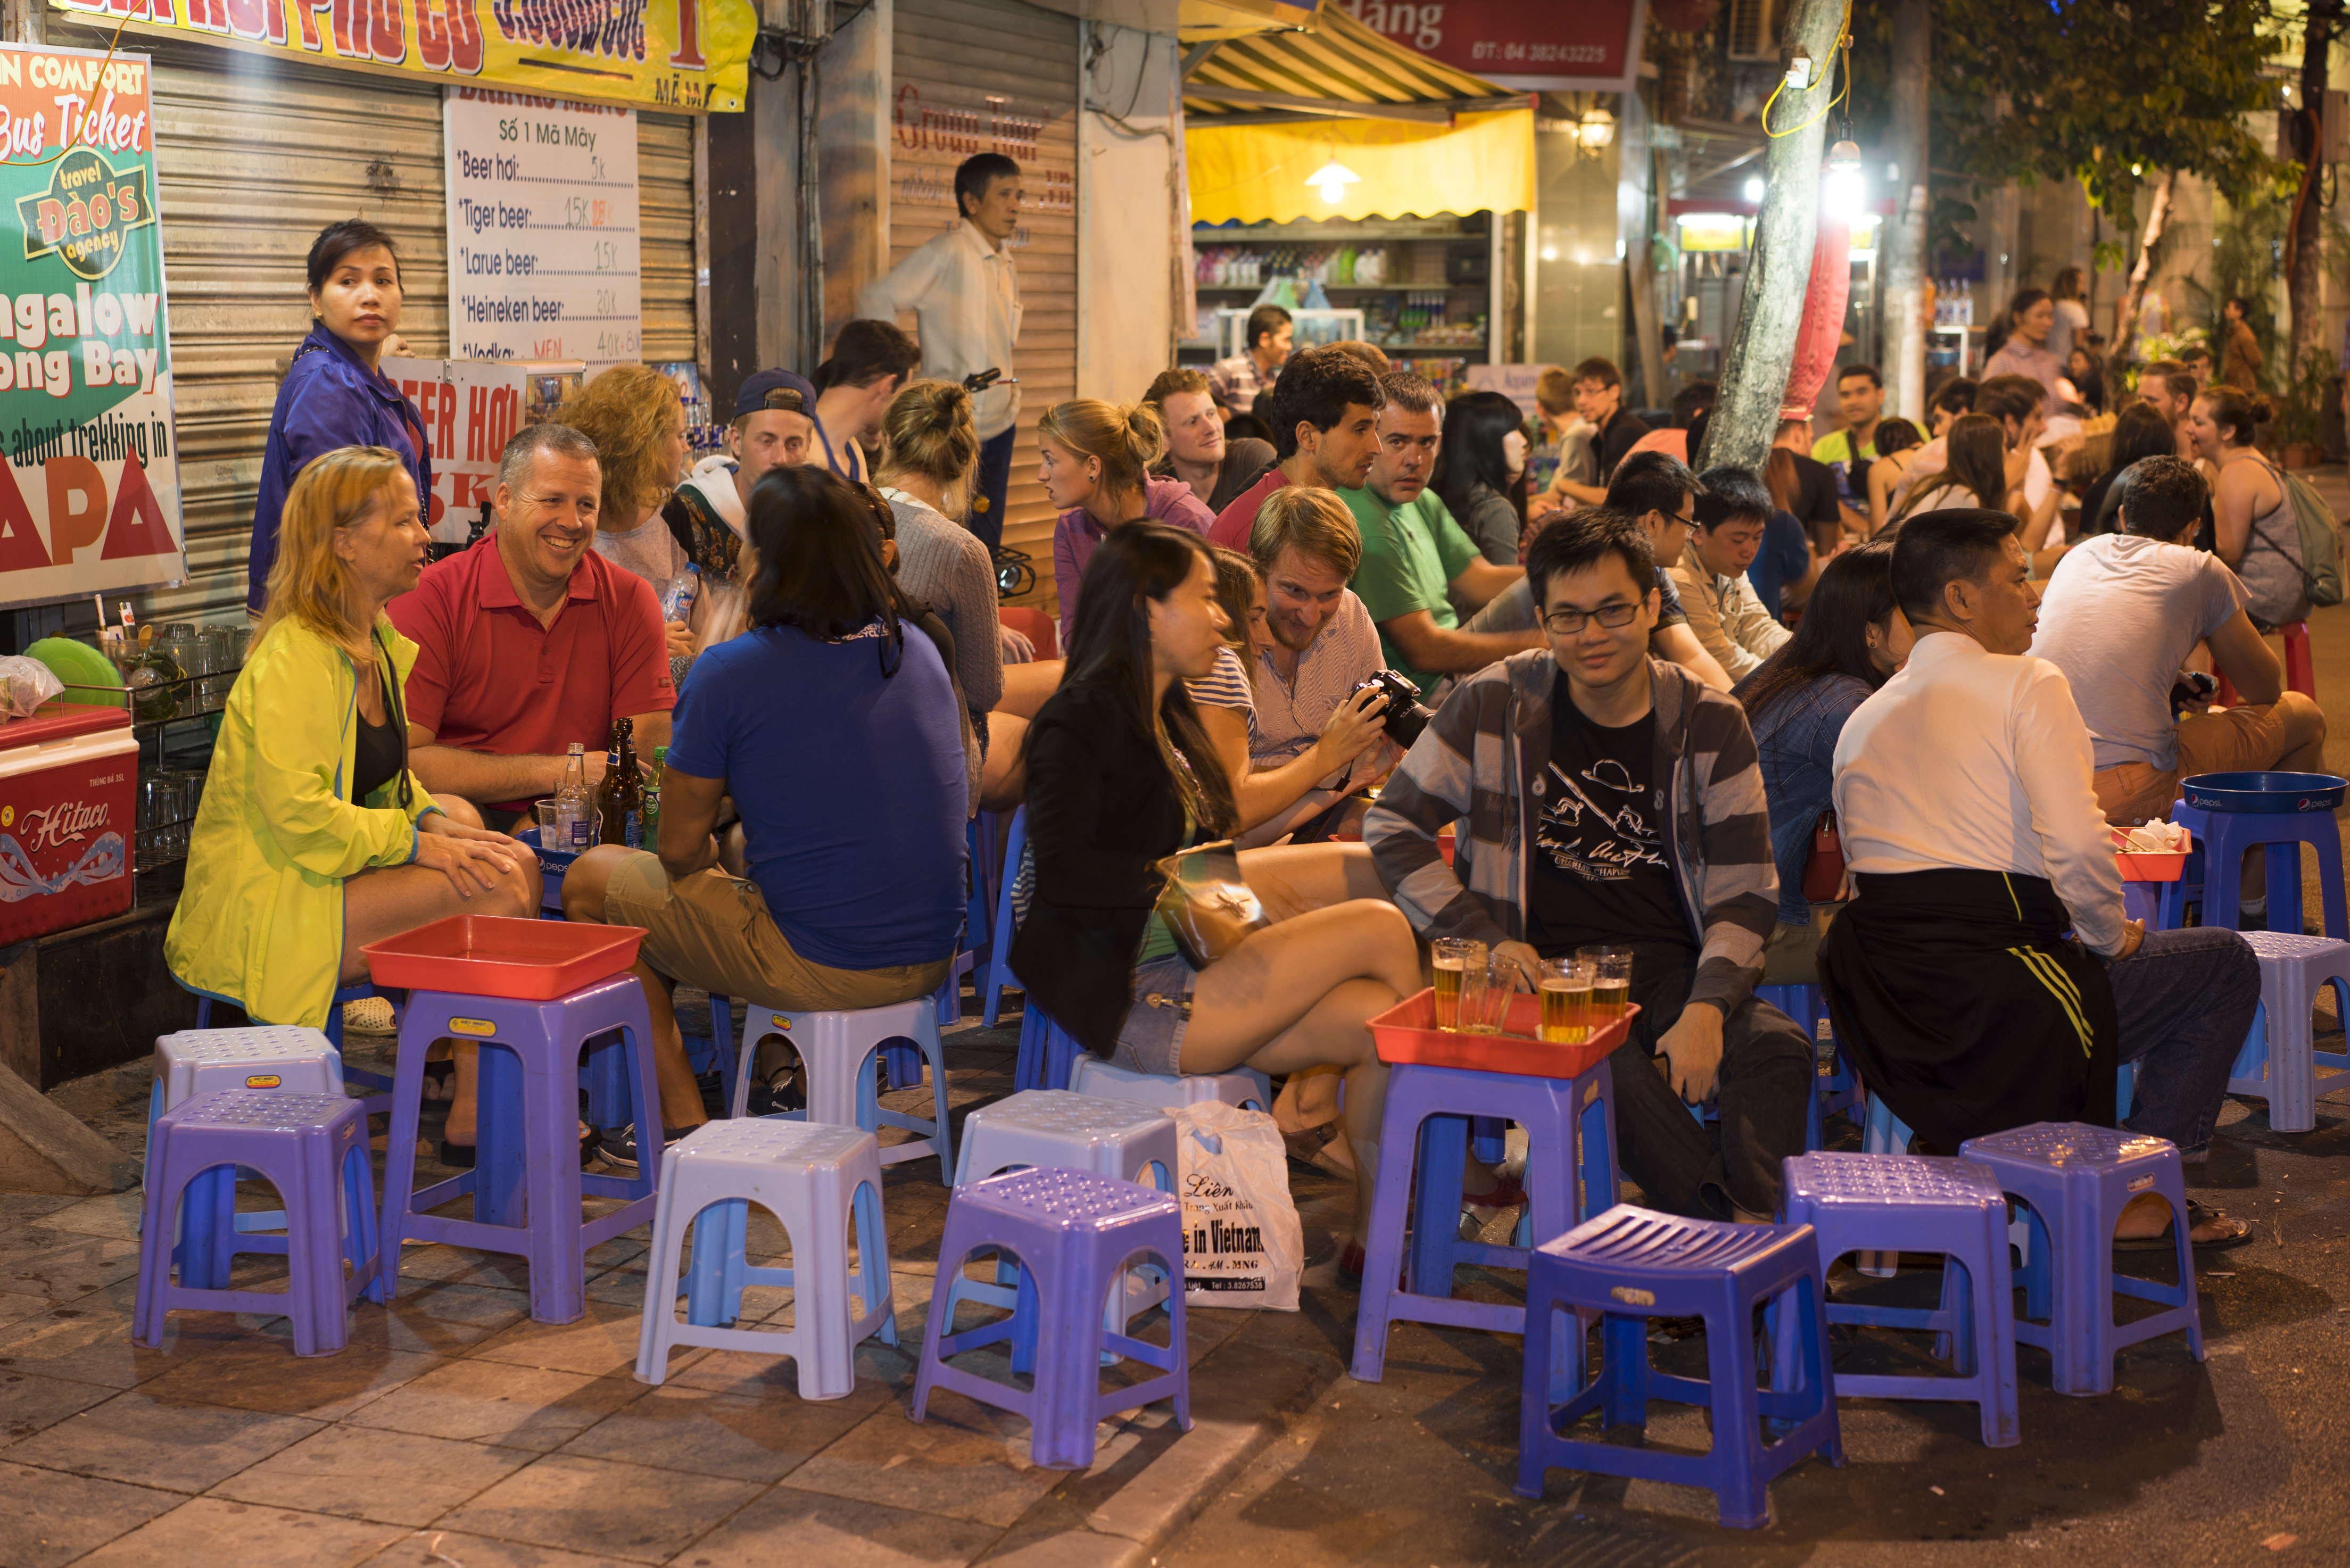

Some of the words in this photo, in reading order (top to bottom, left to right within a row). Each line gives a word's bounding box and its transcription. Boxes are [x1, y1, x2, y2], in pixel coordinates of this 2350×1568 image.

[29, 55, 144, 95] COMFORT
[54, 89, 145, 152] Ticket
[499, 118, 518, 141] Số
[524, 122, 529, 142] 1
[536, 123, 559, 145] Mã
[565, 126, 597, 152] Mây
[59, 160, 101, 189] travel
[66, 230, 119, 262] agency
[467, 295, 528, 322] Heineken
[82, 340, 158, 393] Bay
[12, 418, 64, 468] about
[69, 412, 148, 469] trekking
[151, 410, 168, 458] in
[89, 776, 106, 787] THÙNG
[115, 773, 125, 782] 35L
[1184, 1174, 1234, 1197] Liên
[1194, 1220, 1206, 1254] in
[1211, 1219, 1264, 1254] Vietnam
